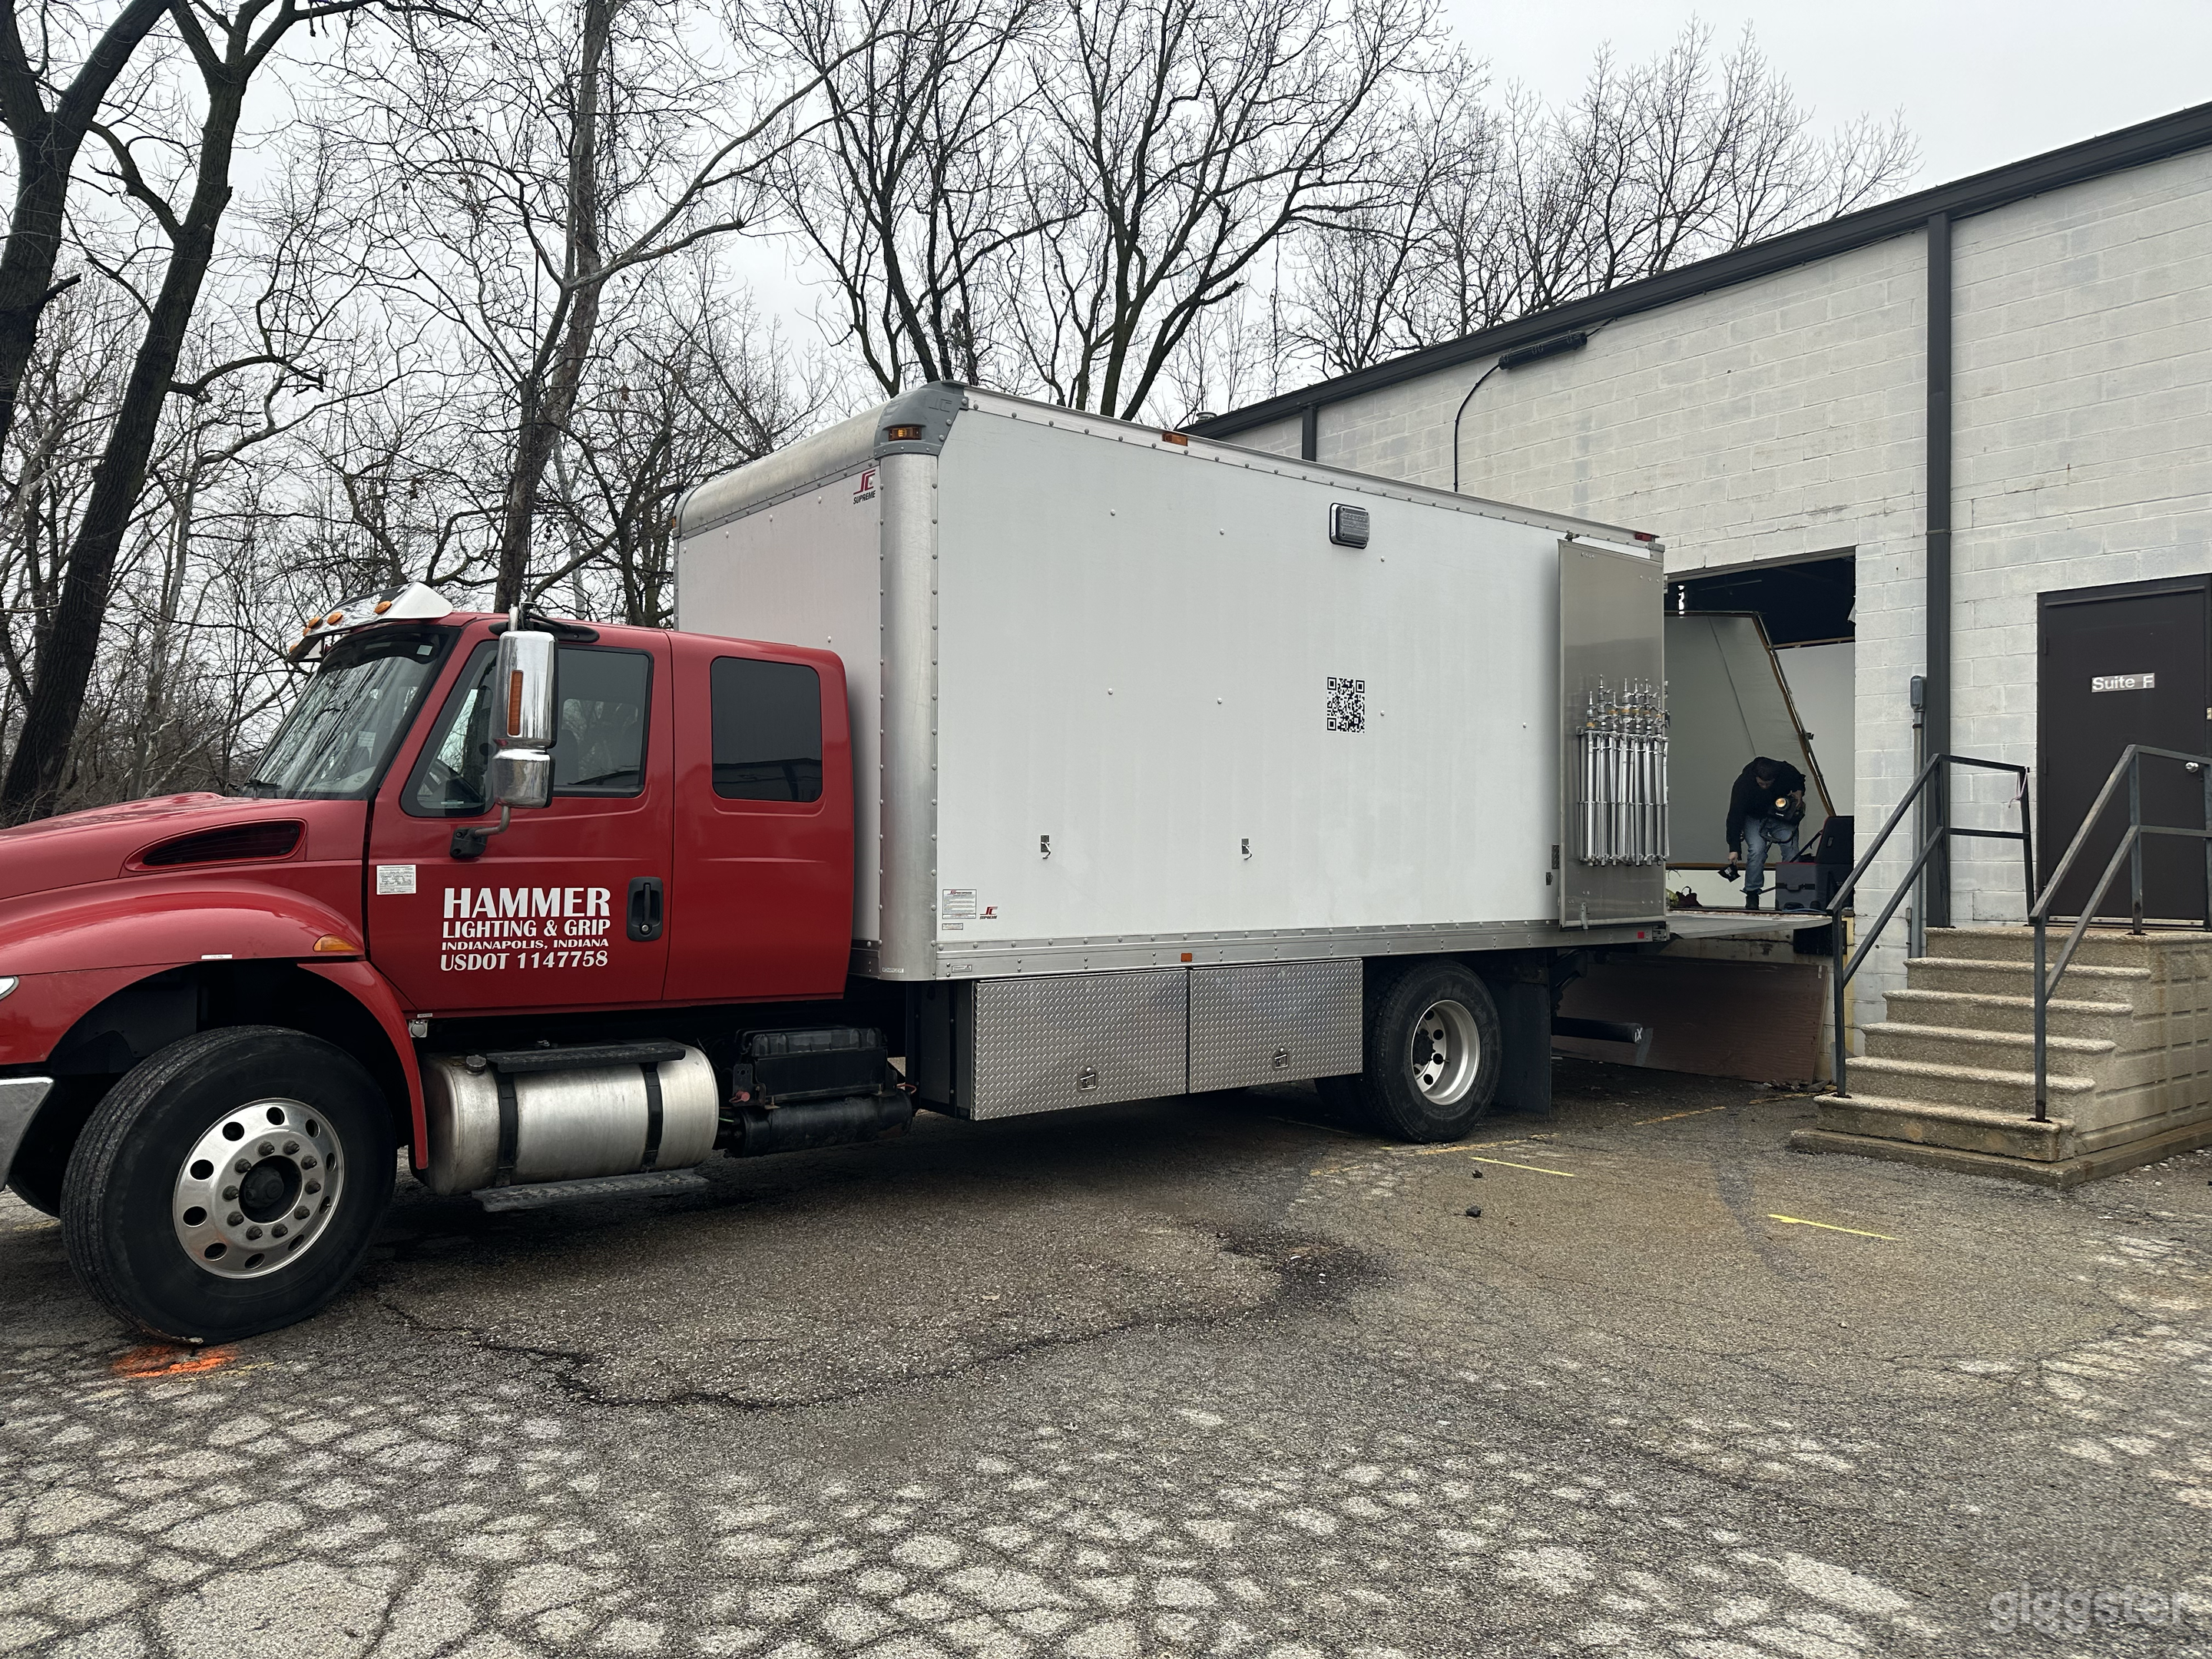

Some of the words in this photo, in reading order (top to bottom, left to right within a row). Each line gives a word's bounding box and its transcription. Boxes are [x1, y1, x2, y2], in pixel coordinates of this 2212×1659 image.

[853, 490, 876, 505] SUPREME
[2092, 676, 2135, 690] Suite
[2143, 674, 2154, 689] F
[443, 887, 611, 919] HAMMER
[442, 919, 537, 939] LIGHTING
[543, 919, 558, 936] &
[564, 919, 611, 935] GRIP
[442, 939, 548, 950] INDIANAPOLIS,
[553, 938, 609, 949] INDIANA
[440, 952, 510, 972] USDOT
[517, 950, 608, 969] 1147758
